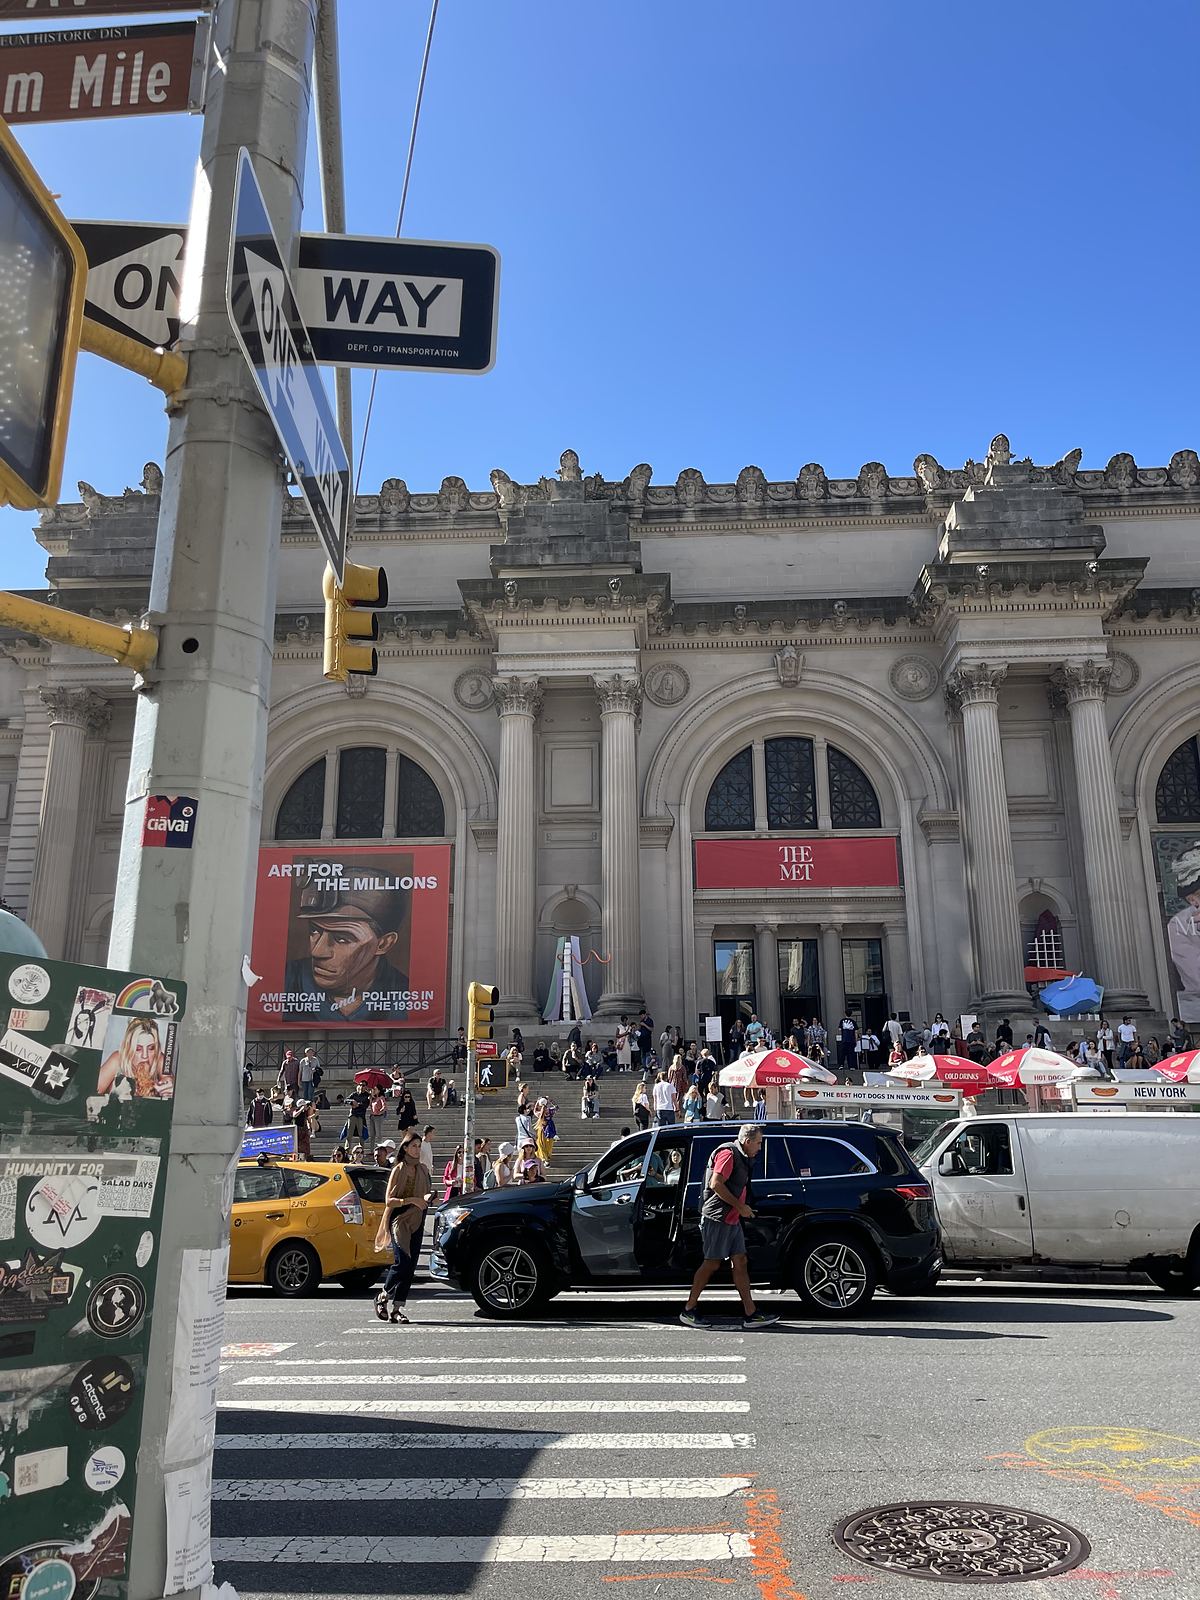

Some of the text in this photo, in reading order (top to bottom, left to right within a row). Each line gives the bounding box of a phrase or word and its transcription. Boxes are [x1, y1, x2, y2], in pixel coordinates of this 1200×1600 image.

[33, 30, 97, 44] HISTORIC
[100, 27, 130, 39] DIST
[69, 50, 171, 109] Mile
[113, 264, 447, 328] ON WAY
[347, 343, 370, 352] DEPT.
[386, 346, 459, 357] TRANSPORTATION
[261, 278, 296, 410] ONE
[314, 416, 339, 519] WAY
[778, 845, 813, 863] THE
[267, 863, 344, 878] ART FOR
[779, 863, 815, 881] MET
[314, 876, 438, 891] THE MILLIONS
[1171, 916, 1200, 936] M
[259, 992, 326, 1003] AMERICAN
[330, 987, 356, 1012] and
[362, 991, 434, 1001] POLITICS IN
[263, 1002, 321, 1012] CULTURE
[366, 1001, 429, 1011] THE 1930S
[1134, 1087, 1186, 1098] NEW YORK
[5, 1162, 105, 1176] HUMANITY FOR
[102, 1179, 153, 1189] SALAD DAYS
